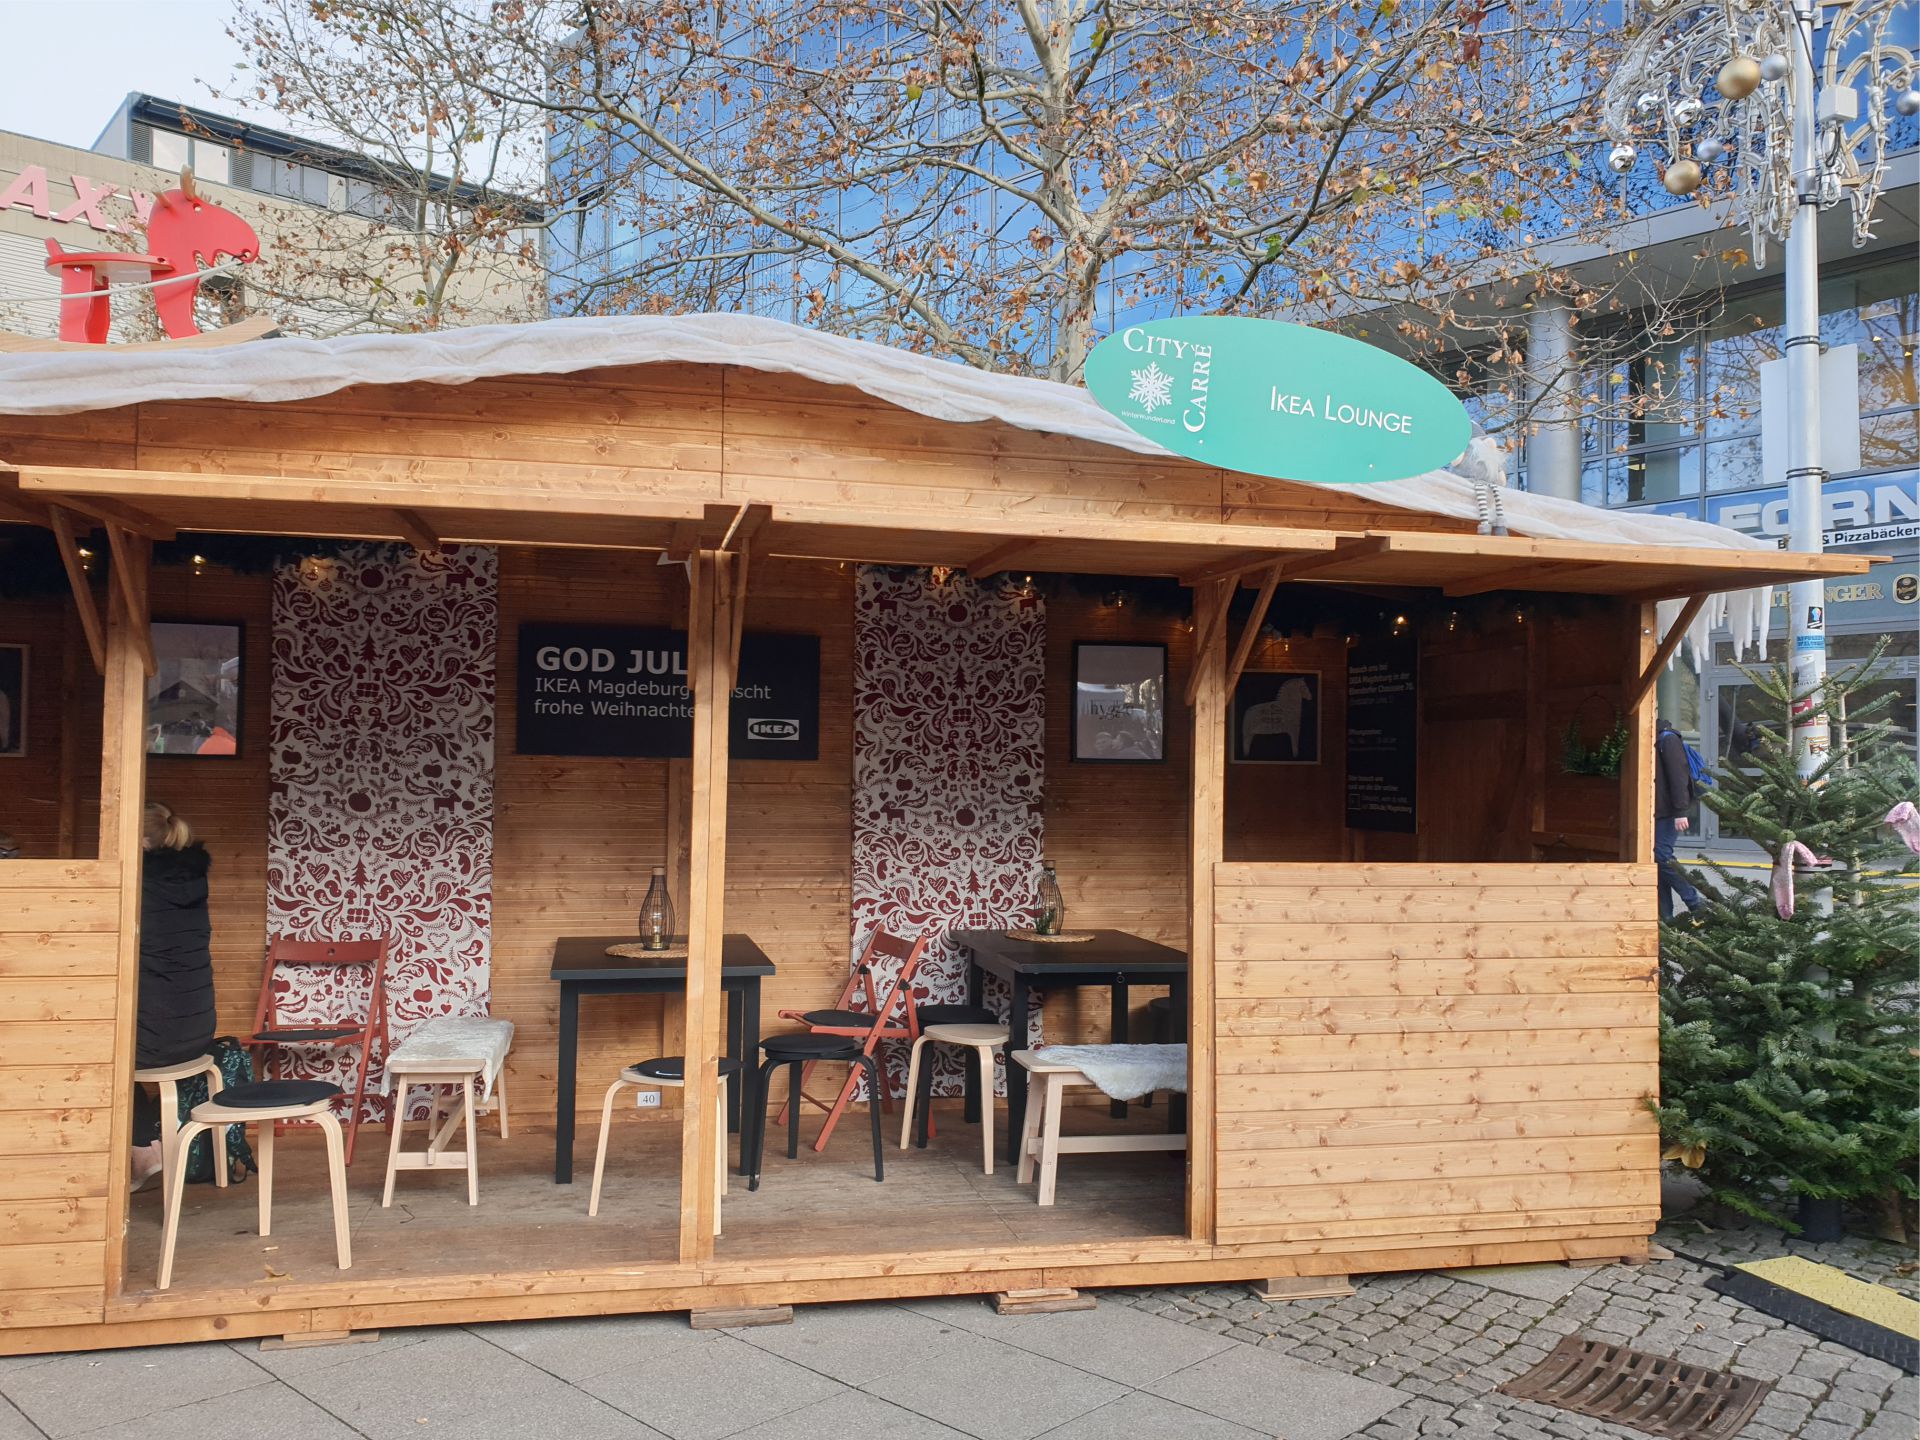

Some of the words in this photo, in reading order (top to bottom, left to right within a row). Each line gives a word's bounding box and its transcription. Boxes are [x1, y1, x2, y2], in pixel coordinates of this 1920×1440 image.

[1123, 328, 1189, 359] CITY
[1270, 385, 1315, 417] IKEA
[1325, 395, 1413, 434] LOUNGE
[536, 646, 615, 672] GOD
[626, 650, 689, 674] JUL
[535, 677, 581, 693] IKEA
[588, 679, 690, 700] Magdeburg
[730, 683, 772, 700] scht
[534, 699, 584, 715] frohe
[591, 701, 695, 718] Weihnachte
[752, 724, 796, 734] IKEA
[643, 1095, 655, 1104] 40
